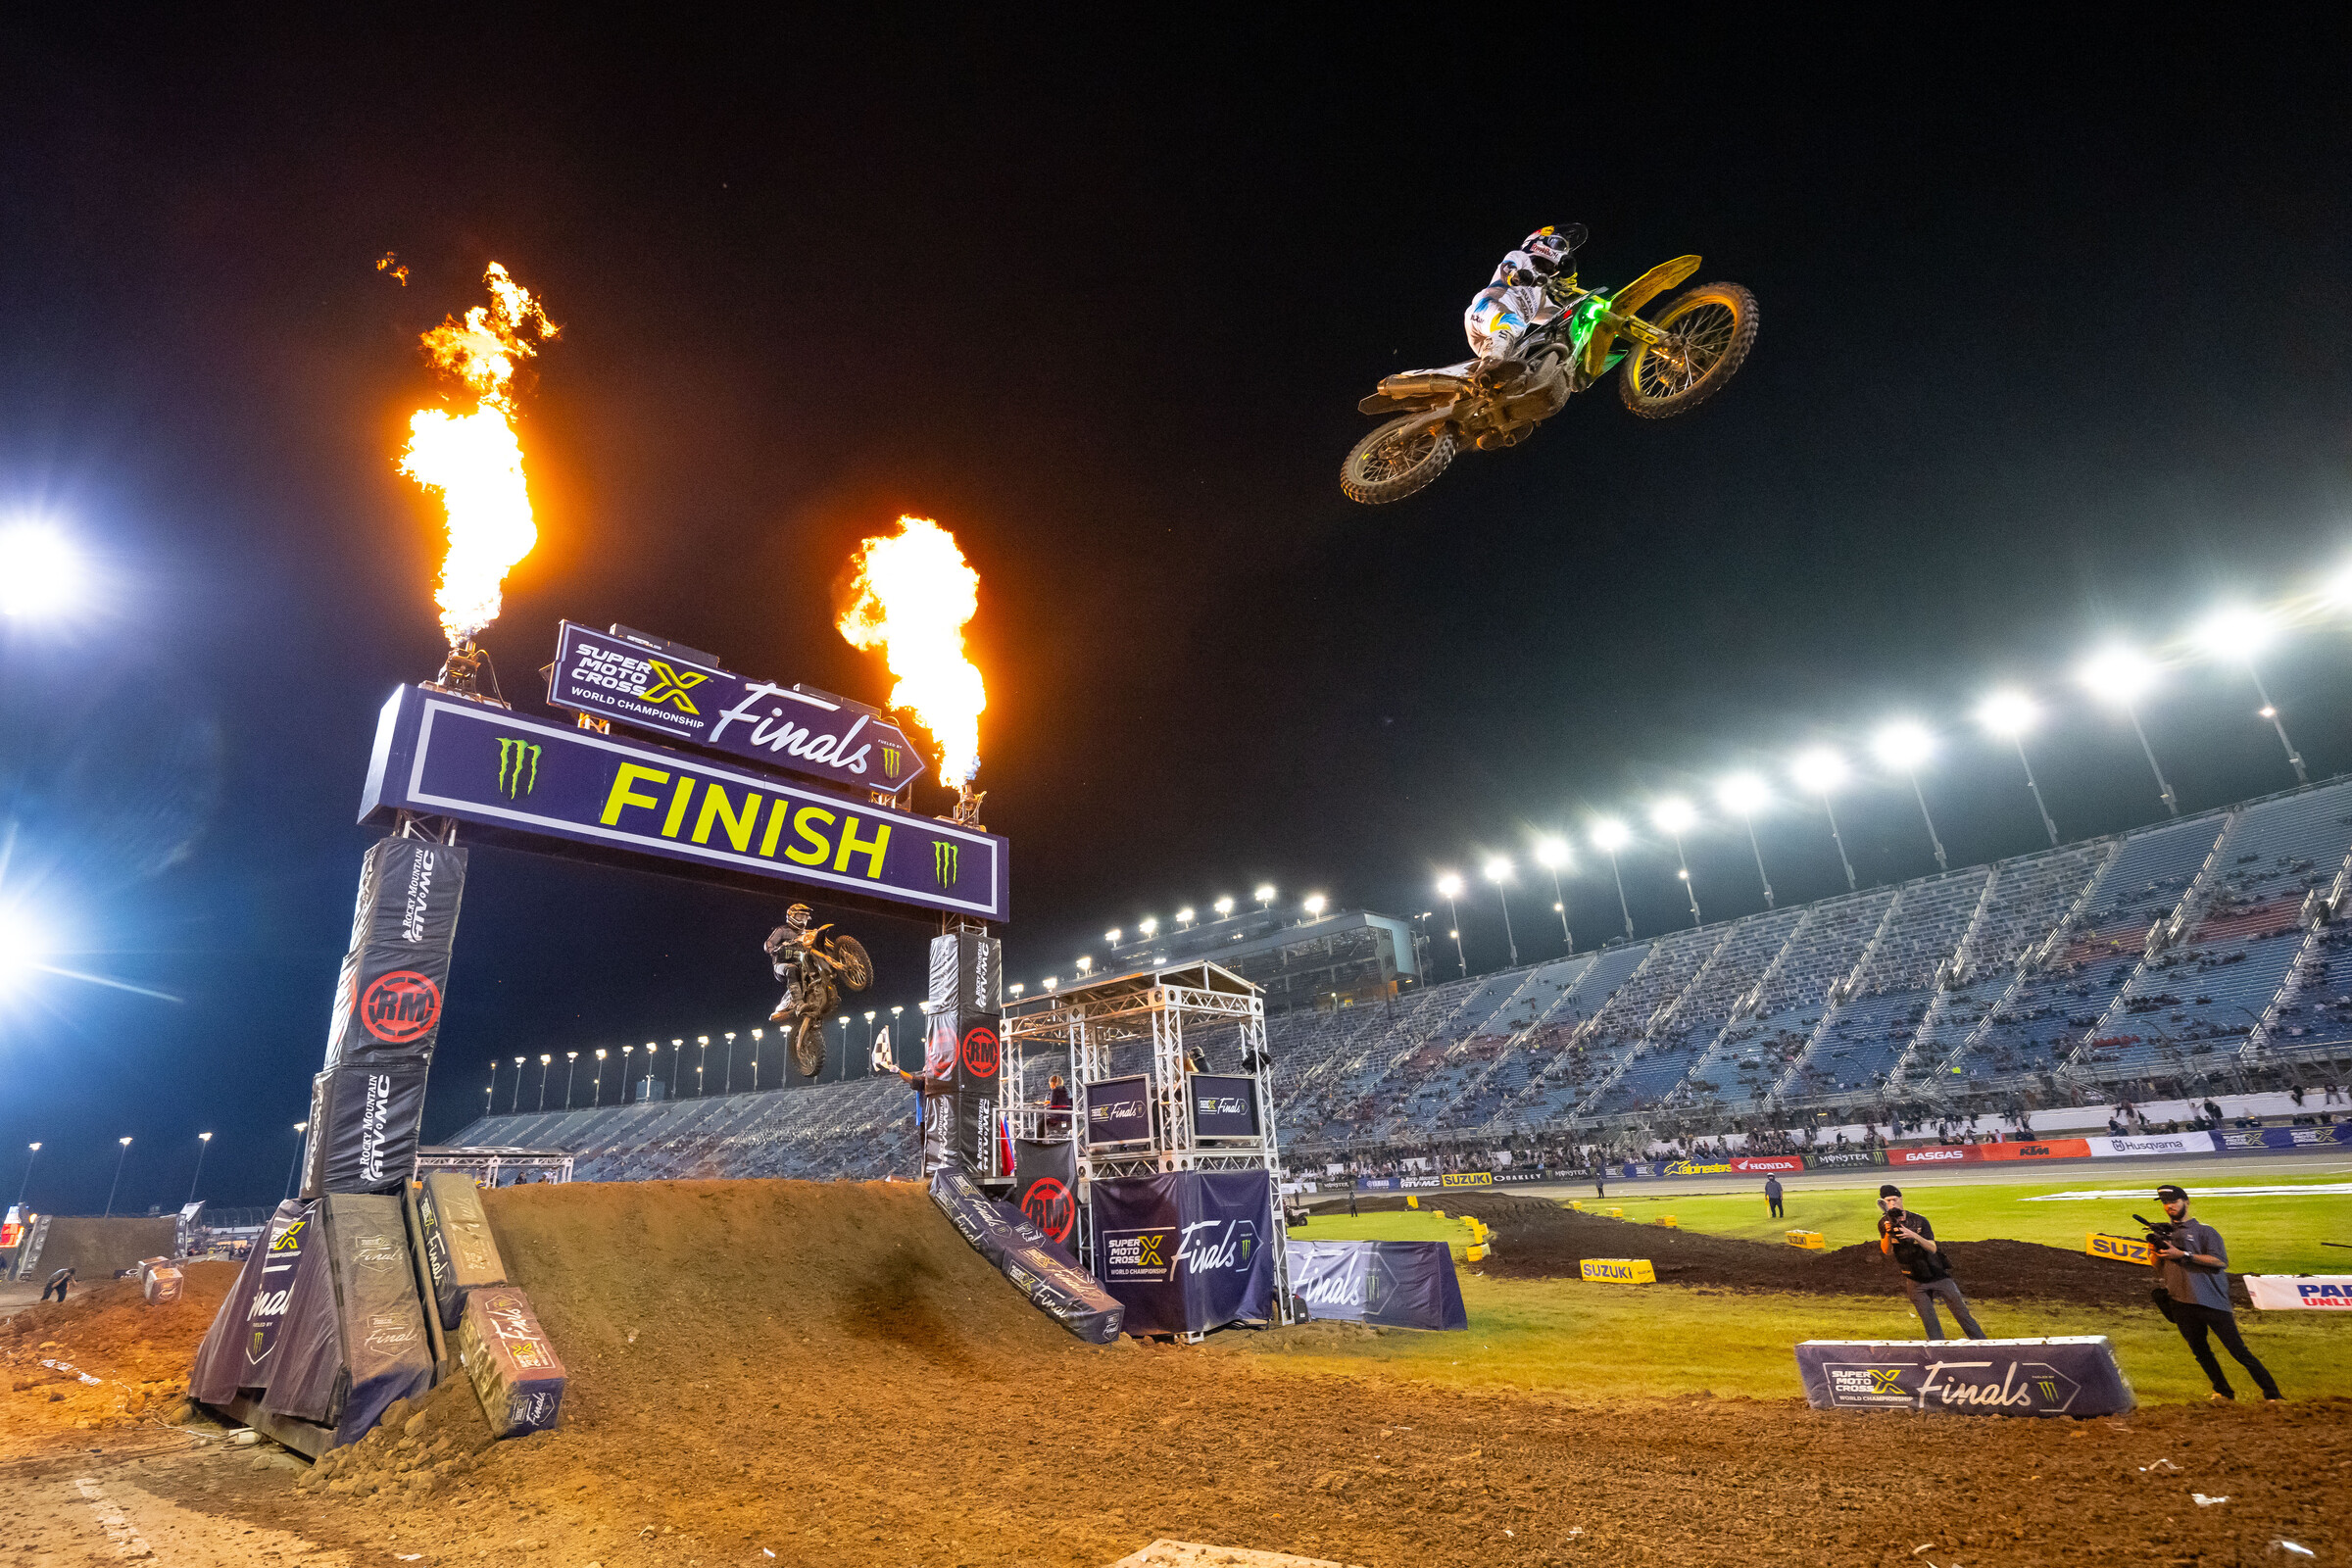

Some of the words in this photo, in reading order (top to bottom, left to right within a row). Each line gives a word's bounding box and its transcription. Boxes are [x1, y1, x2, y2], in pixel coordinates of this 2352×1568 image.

[575, 643, 653, 675] SUPER
[578, 657, 647, 684] MOTO
[571, 667, 647, 697] CROSS
[571, 686, 615, 705] WORLD
[617, 699, 705, 729] CHAMPIONSHIP
[709, 682, 872, 774] Finals
[600, 761, 892, 879] FINISH
[363, 1074, 378, 1130] MOUNTAIN
[1110, 1101, 1137, 1121] Finals
[1217, 1097, 1241, 1114] Finals
[360, 1132, 372, 1165] ROCKY
[1906, 1151, 1963, 1161] GASGAS
[2020, 1146, 2050, 1156] KTM
[2126, 1140, 2183, 1152] Husqvarna
[1749, 1161, 1793, 1170] HONDA
[1819, 1152, 1870, 1163] MONSTER
[1682, 1163, 1733, 1175] alpinestars
[1445, 1174, 1491, 1186] SUZUKI
[1108, 1239, 1141, 1248] SUPER
[2092, 1238, 2148, 1261] SUZ
[1108, 1255, 1141, 1264] CROSS
[1291, 1248, 1361, 1305] Finals
[1583, 1263, 1634, 1279] SUZUKI
[1033, 1283, 1072, 1317] Final
[1832, 1370, 1871, 1379] SUPER
[1917, 1360, 2032, 1408] Finals
[526, 1392, 546, 1426] Finals
